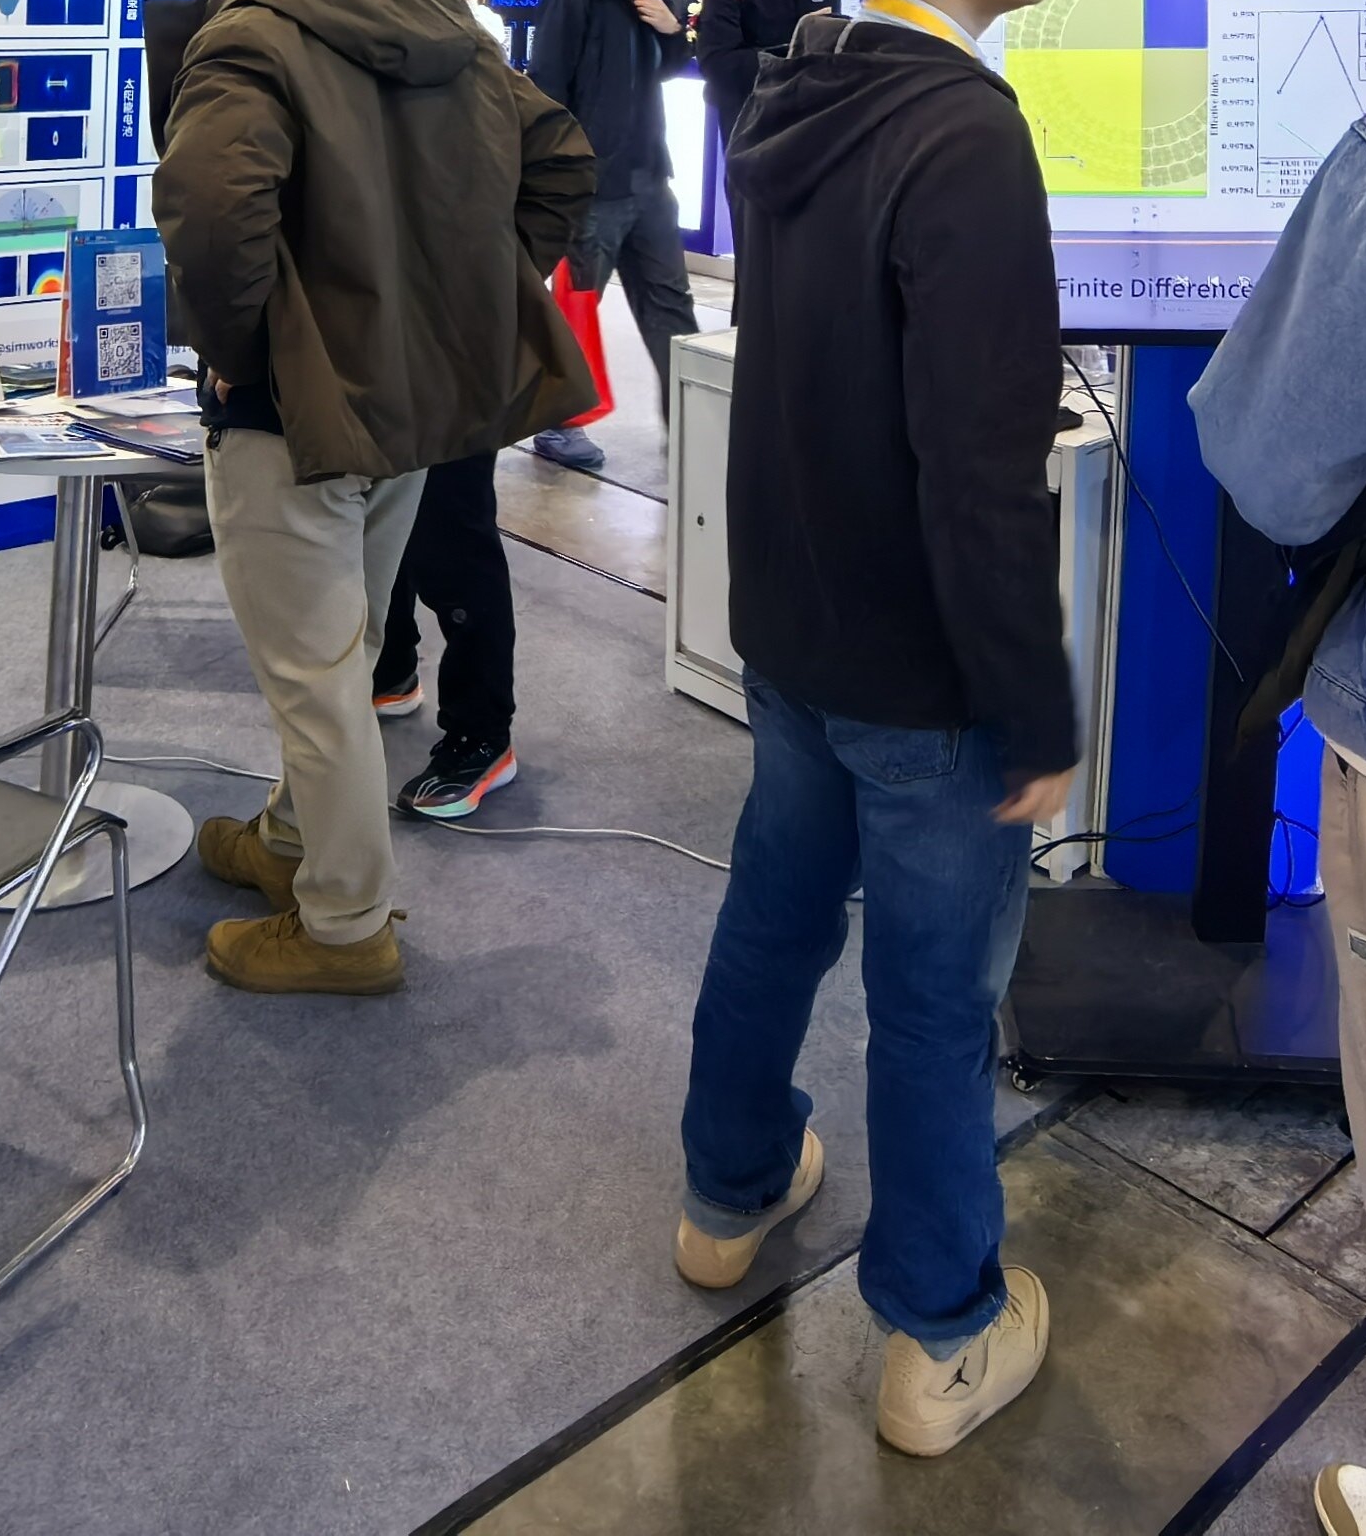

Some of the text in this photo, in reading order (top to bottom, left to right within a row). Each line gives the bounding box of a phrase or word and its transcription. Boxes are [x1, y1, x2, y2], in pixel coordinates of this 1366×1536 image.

[121, 78, 135, 138] 太阳能电池
[1057, 275, 1253, 299] Finite Difference
